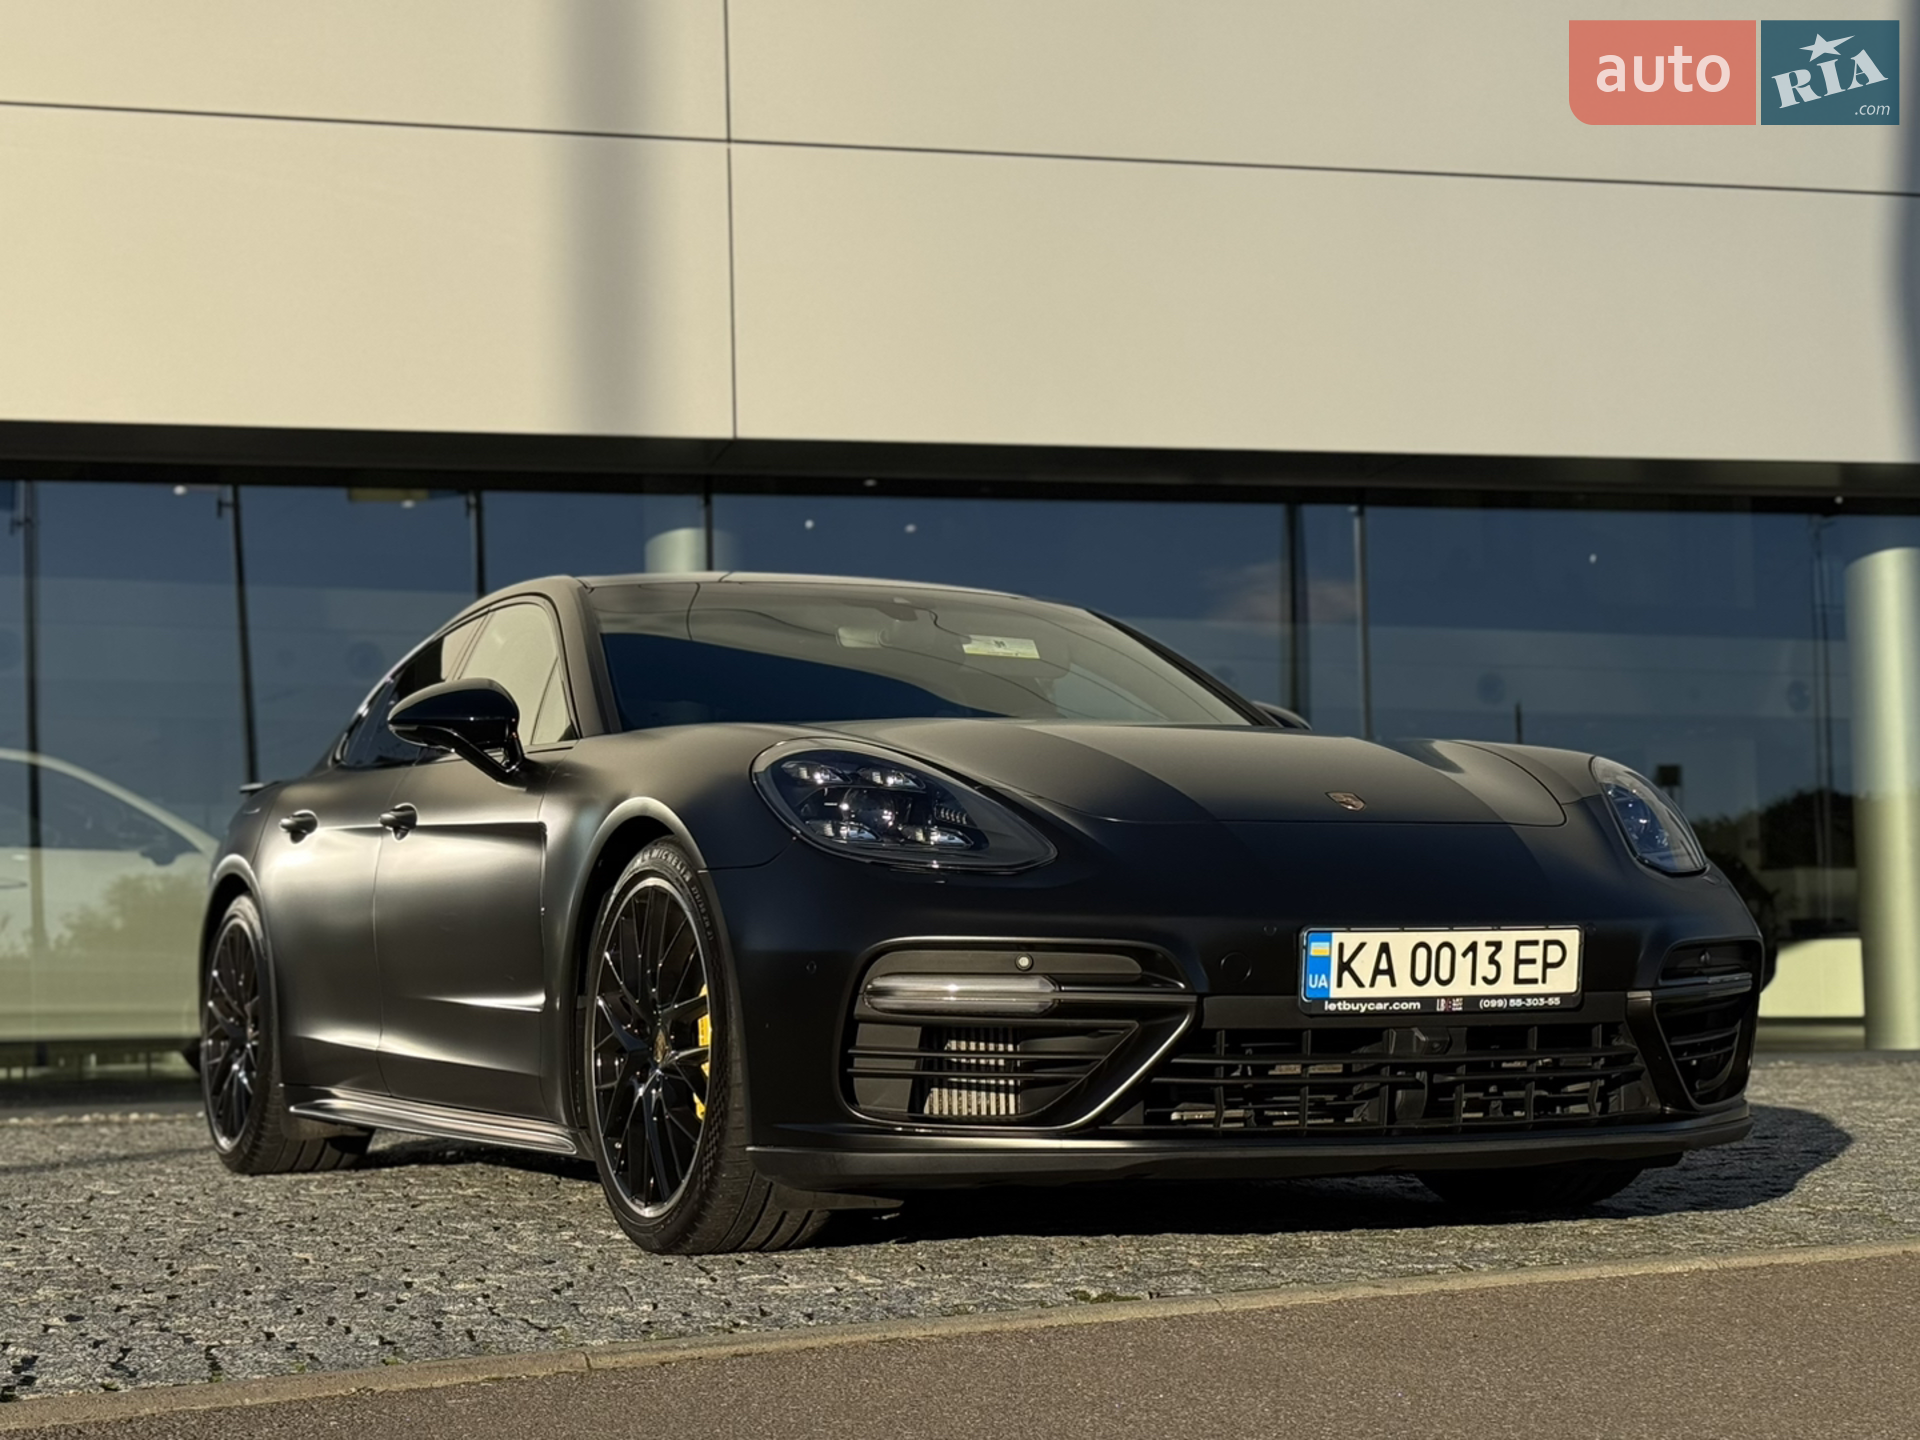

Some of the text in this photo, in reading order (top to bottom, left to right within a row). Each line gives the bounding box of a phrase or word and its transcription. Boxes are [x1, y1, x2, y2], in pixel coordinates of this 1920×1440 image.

[1336, 939, 1567, 988] KA 0013 EP
[1308, 974, 1328, 989] UA
[1323, 1000, 1421, 1013] letbuycar.com
[1479, 998, 1507, 1010] (099)
